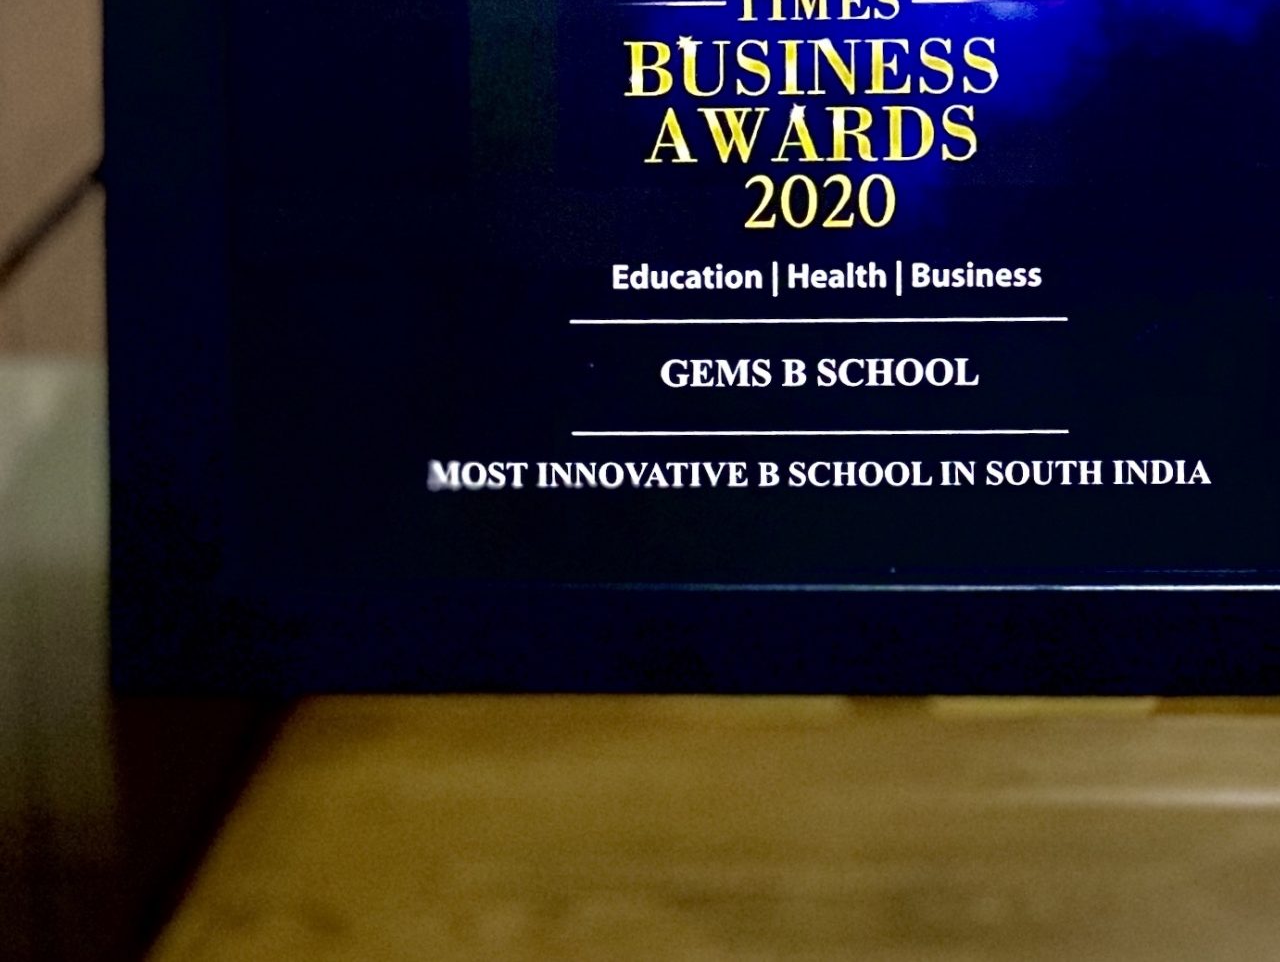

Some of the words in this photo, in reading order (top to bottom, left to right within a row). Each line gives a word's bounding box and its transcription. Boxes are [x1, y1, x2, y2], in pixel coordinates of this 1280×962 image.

[624, 36, 998, 96] BUSINESS
[644, 104, 976, 163] AWARDS
[745, 174, 895, 228] 2020
[613, 263, 762, 289] Education
[788, 262, 886, 288] Health
[912, 262, 1042, 287] Business
[661, 359, 771, 387] GEMS
[782, 359, 806, 386] B
[817, 358, 979, 387] SCHOOL
[428, 461, 528, 490] MOST
[537, 462, 748, 488] INNOVATIVE
[758, 462, 779, 486] B
[789, 462, 932, 486] SCHOOL
[941, 461, 975, 485] IN
[986, 461, 1103, 485] SOUTH
[1113, 460, 1211, 484] INDIA
